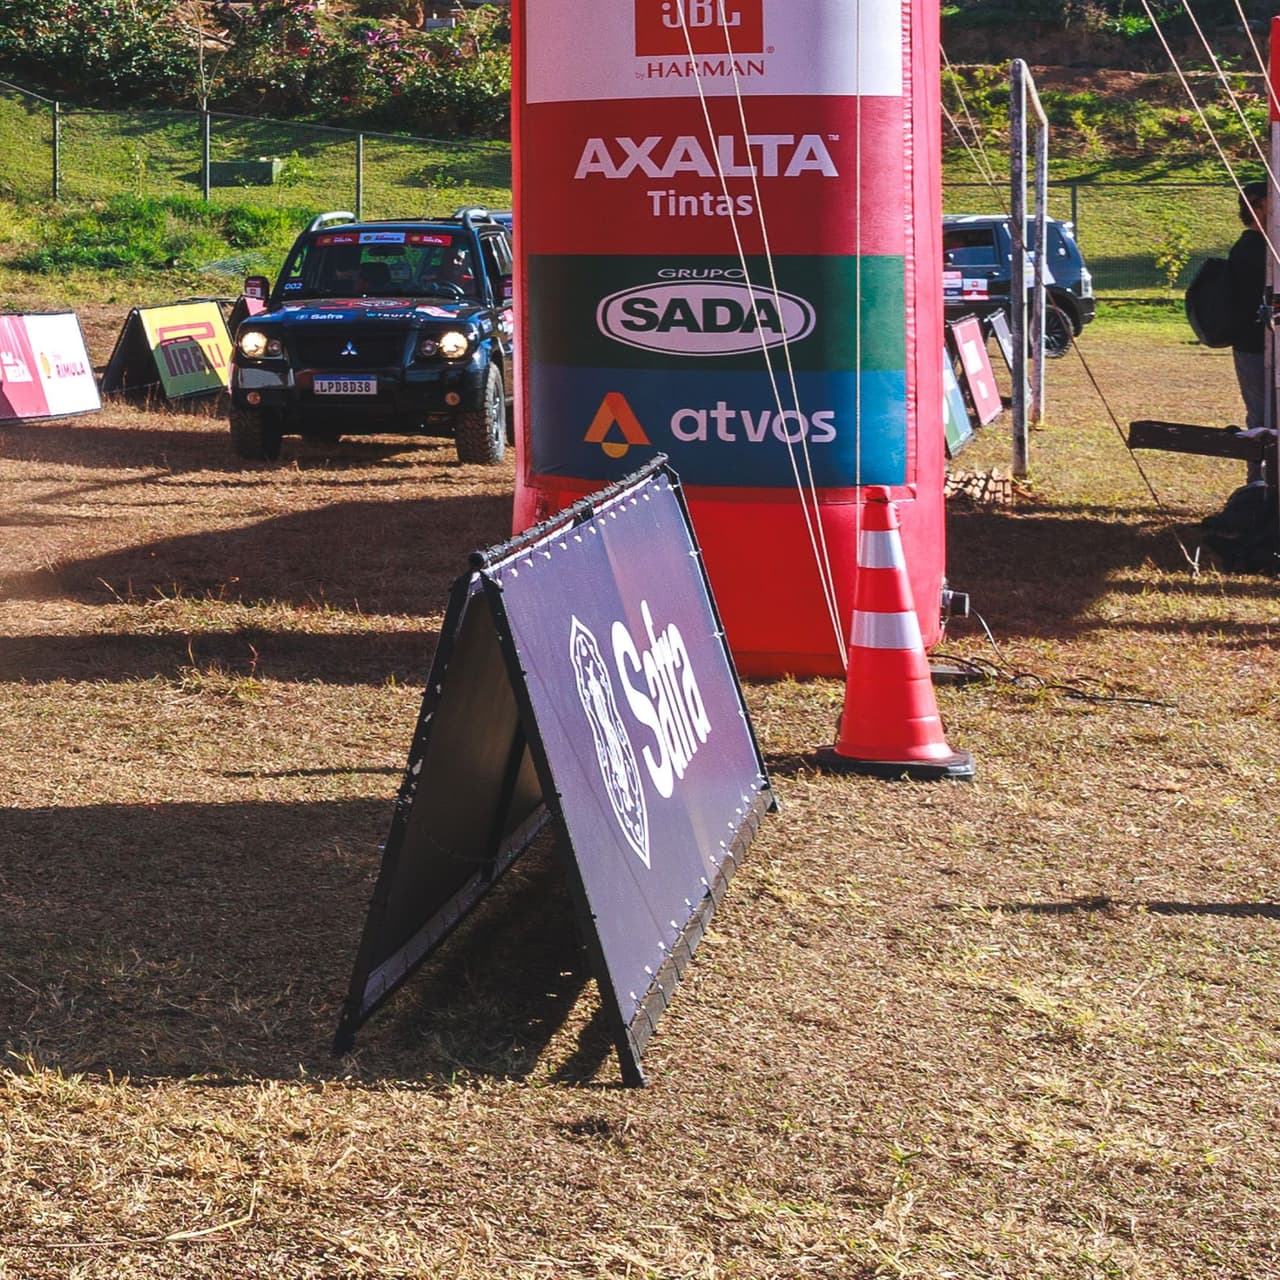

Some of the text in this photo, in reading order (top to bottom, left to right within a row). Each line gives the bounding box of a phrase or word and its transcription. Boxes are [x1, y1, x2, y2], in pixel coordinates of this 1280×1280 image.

[647, 60, 765, 79] HARMAN
[647, 190, 753, 216] Tintas
[657, 268, 747, 279] GRUPO
[620, 297, 787, 334] SADA
[54, 360, 87, 379] RIMULA
[320, 381, 371, 393] LPD8D38
[670, 401, 837, 443] atvos
[611, 599, 712, 798] Safra
